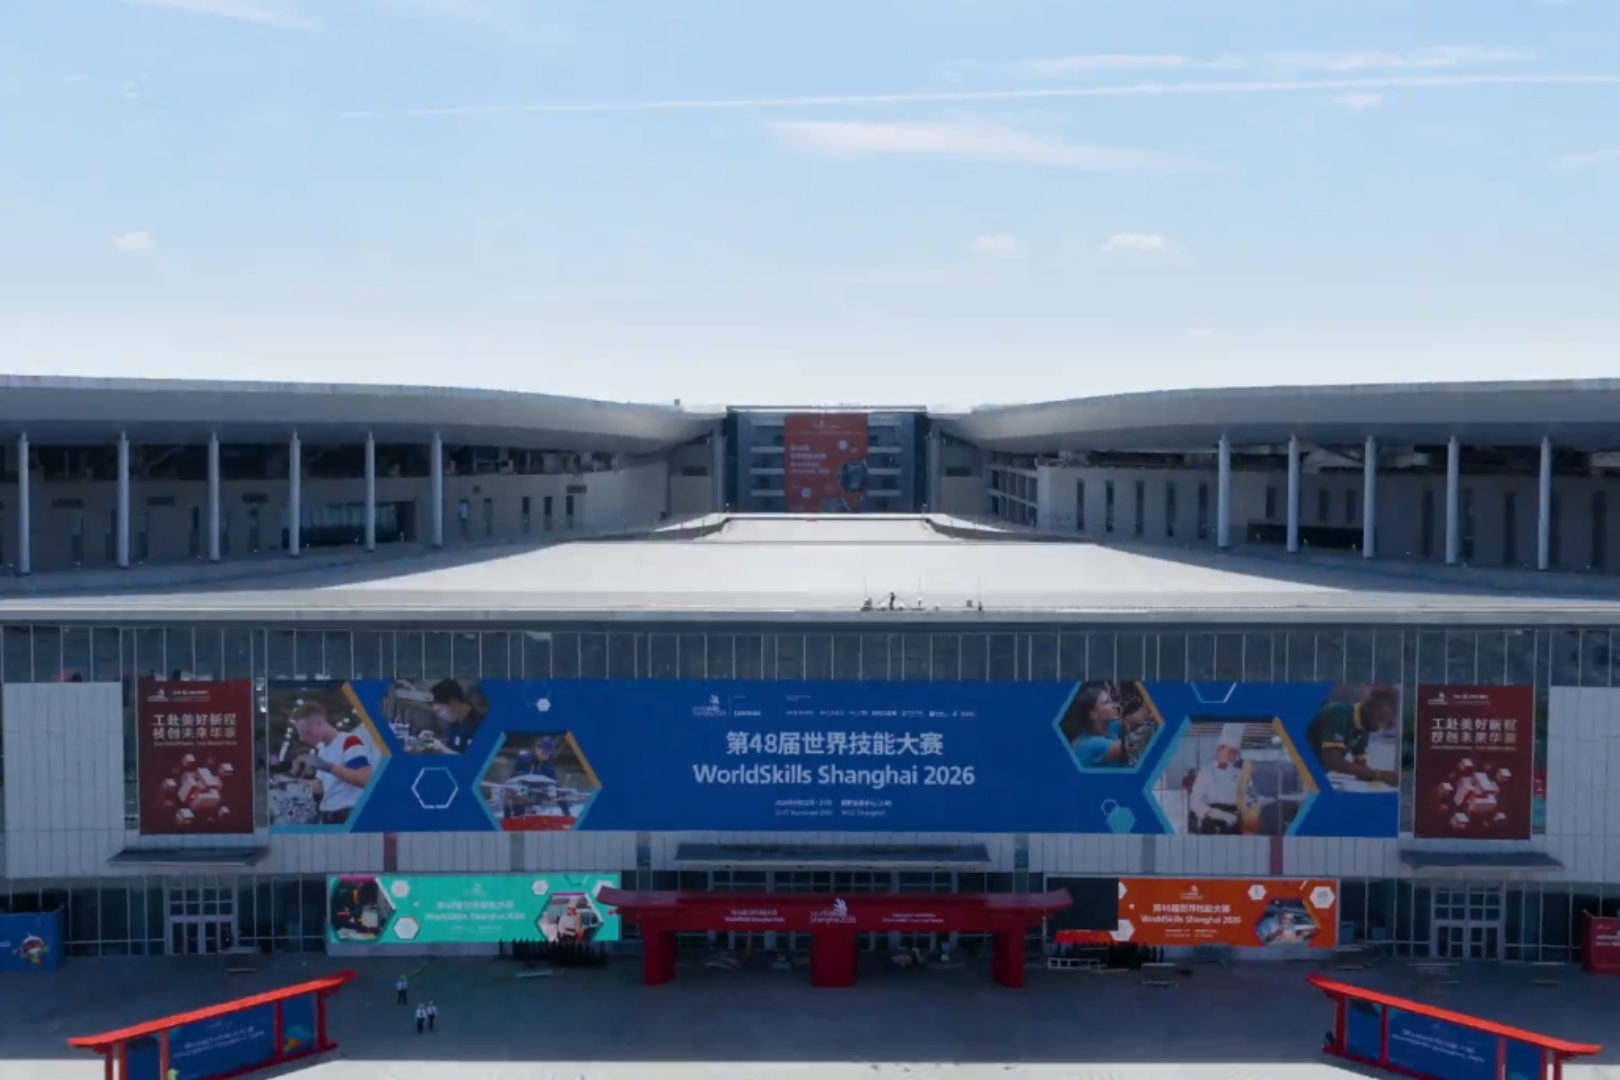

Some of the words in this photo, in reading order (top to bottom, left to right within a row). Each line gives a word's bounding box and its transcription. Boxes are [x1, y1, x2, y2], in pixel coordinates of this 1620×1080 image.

[726, 731, 944, 755] 第48届世界技能大赛
[1431, 731, 1516, 744] 技创未来华
[692, 764, 812, 785] WorldSkills
[817, 764, 918, 789] Shanghai
[923, 766, 976, 785] 2026
